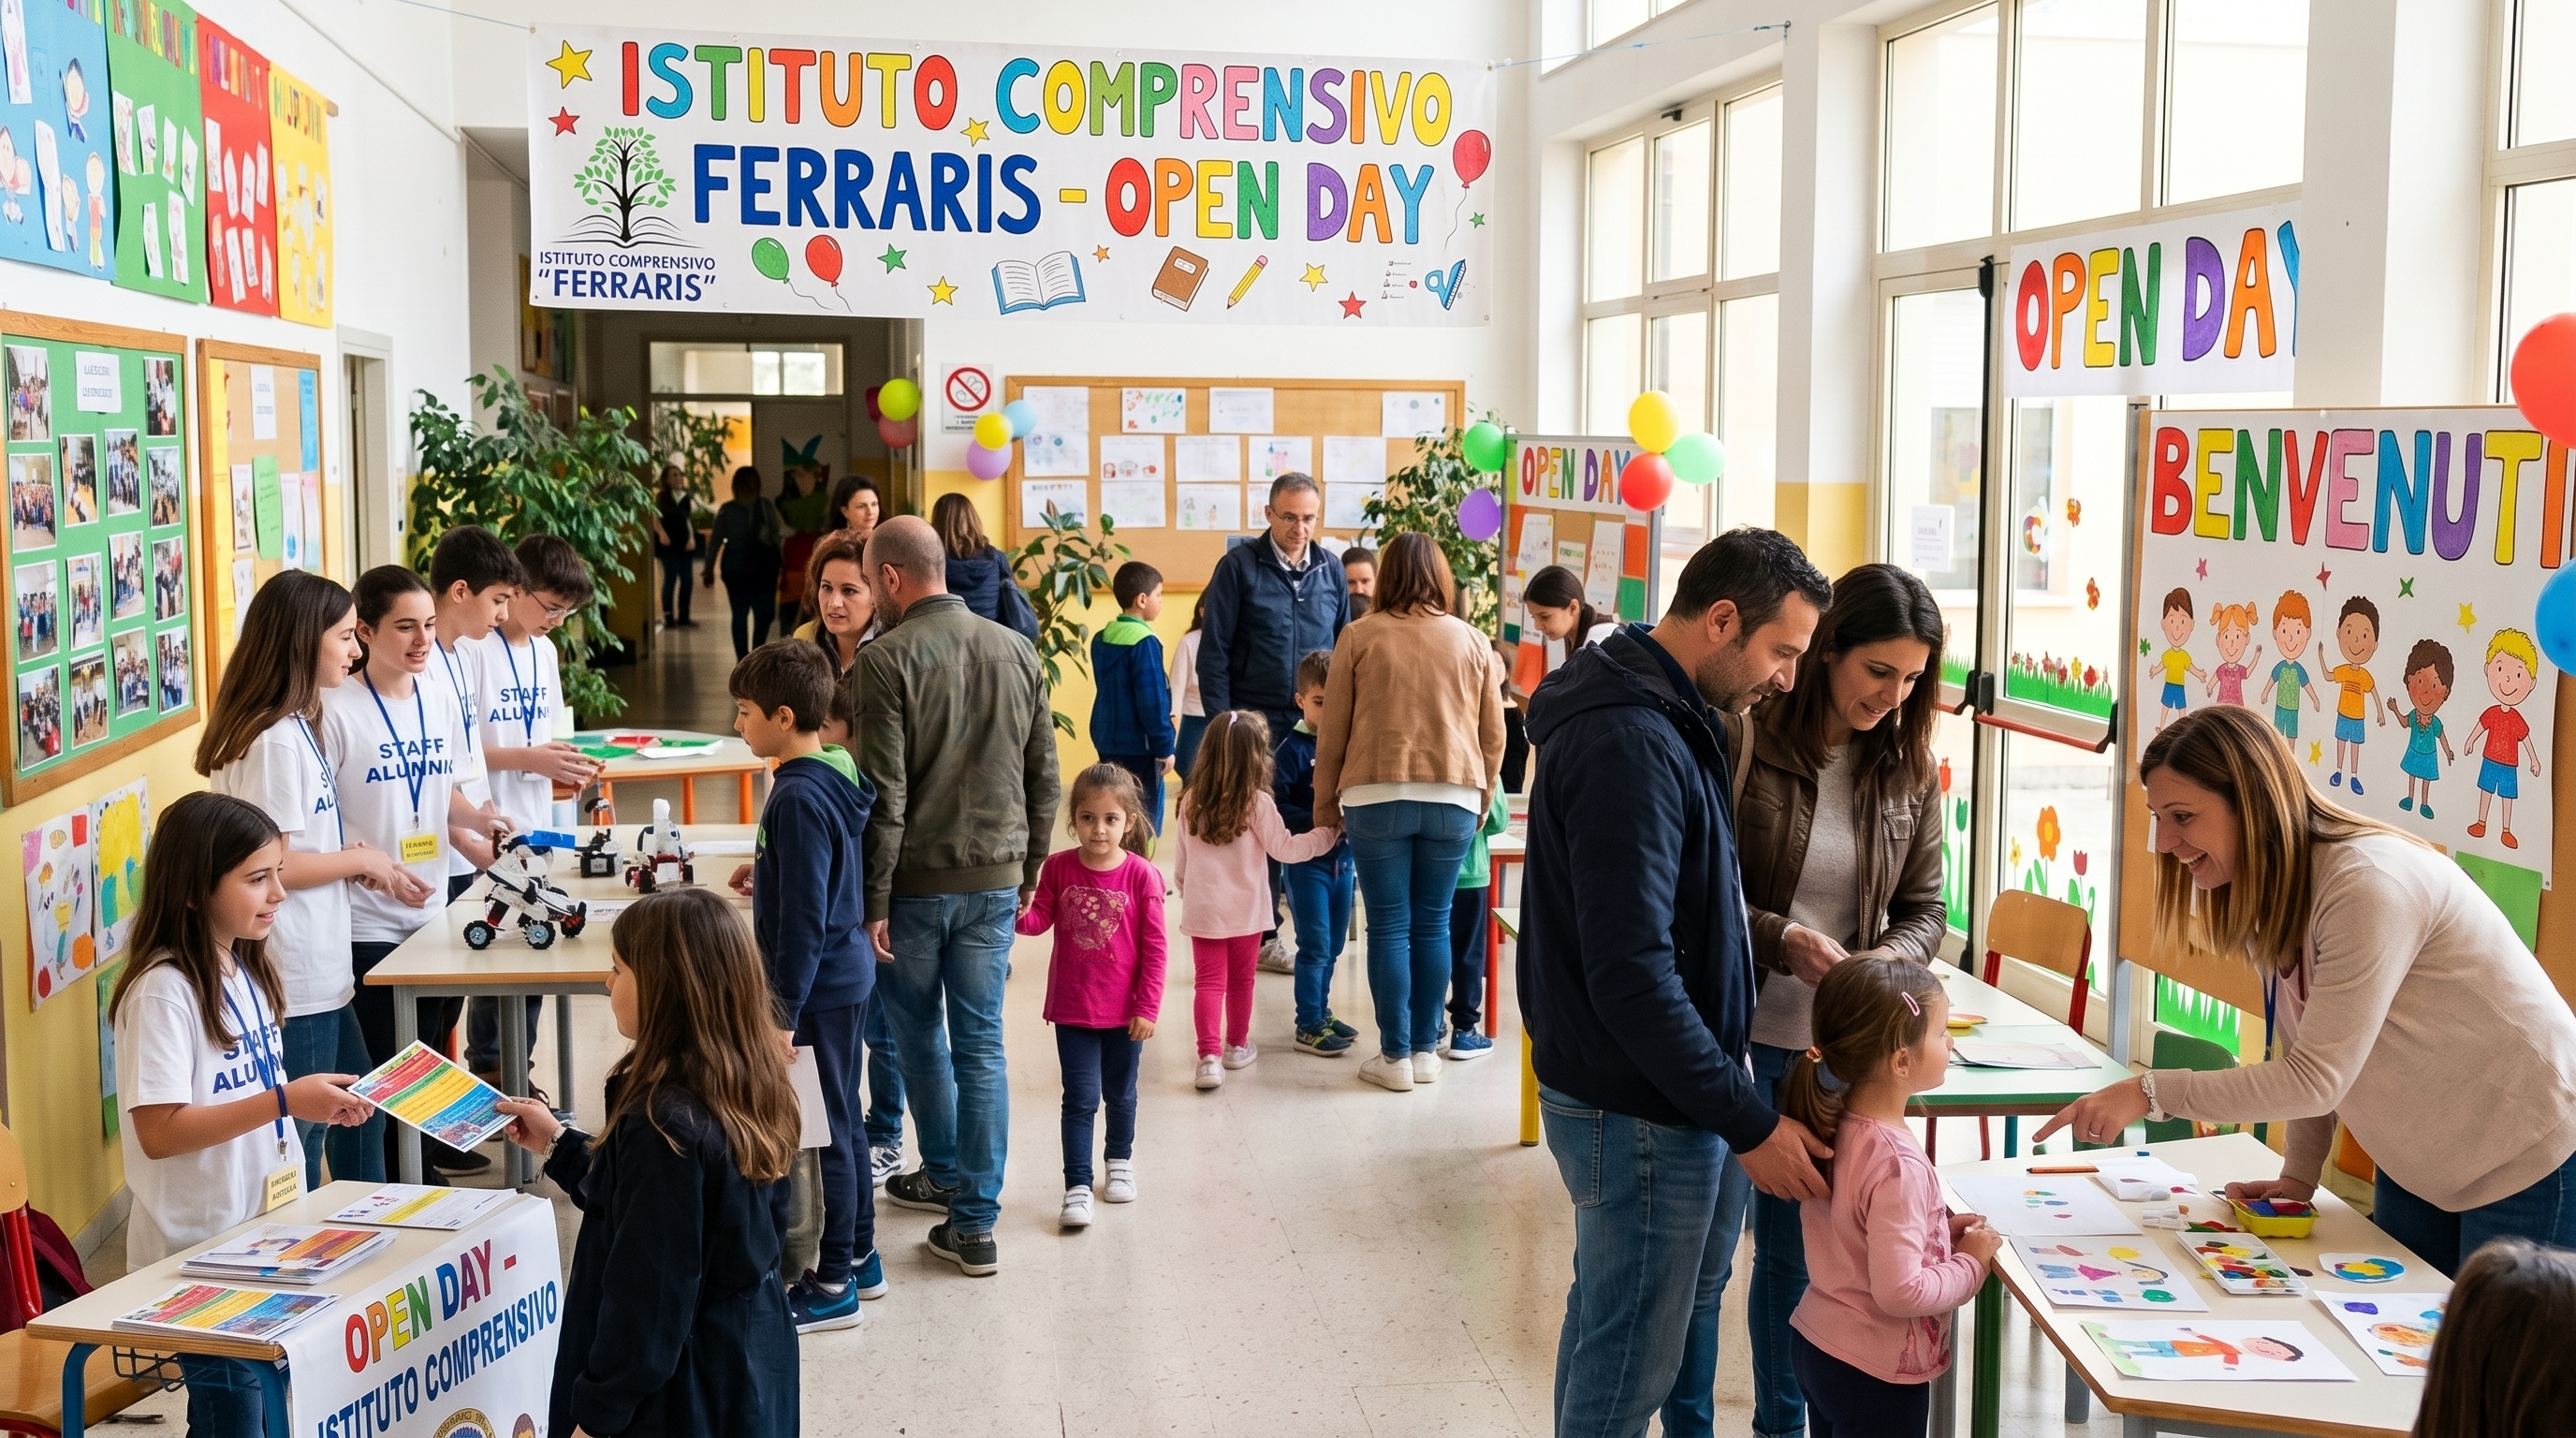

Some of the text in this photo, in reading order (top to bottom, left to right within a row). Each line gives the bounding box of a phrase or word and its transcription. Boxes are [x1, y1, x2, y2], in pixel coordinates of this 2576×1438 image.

[622, 41, 1453, 147] ISTITUTO COMPRENSIVO
[694, 143, 1435, 245] FERRARIS - OPEN DAY
[539, 251, 716, 271] ISTITUTO COMPRENSIVO
[2015, 242, 2162, 372] OPEN
[1522, 446, 1631, 505] OPEN DAY
[2150, 426, 2569, 570] BENVENUTI
[500, 686, 547, 703] STAFF
[379, 738, 444, 759] STAFF
[223, 1021, 278, 1061] STAFF
[344, 1275, 432, 1373] OPEN
[435, 1239, 491, 1322] DAY
[425, 1280, 558, 1402] COMPRENSIVO
